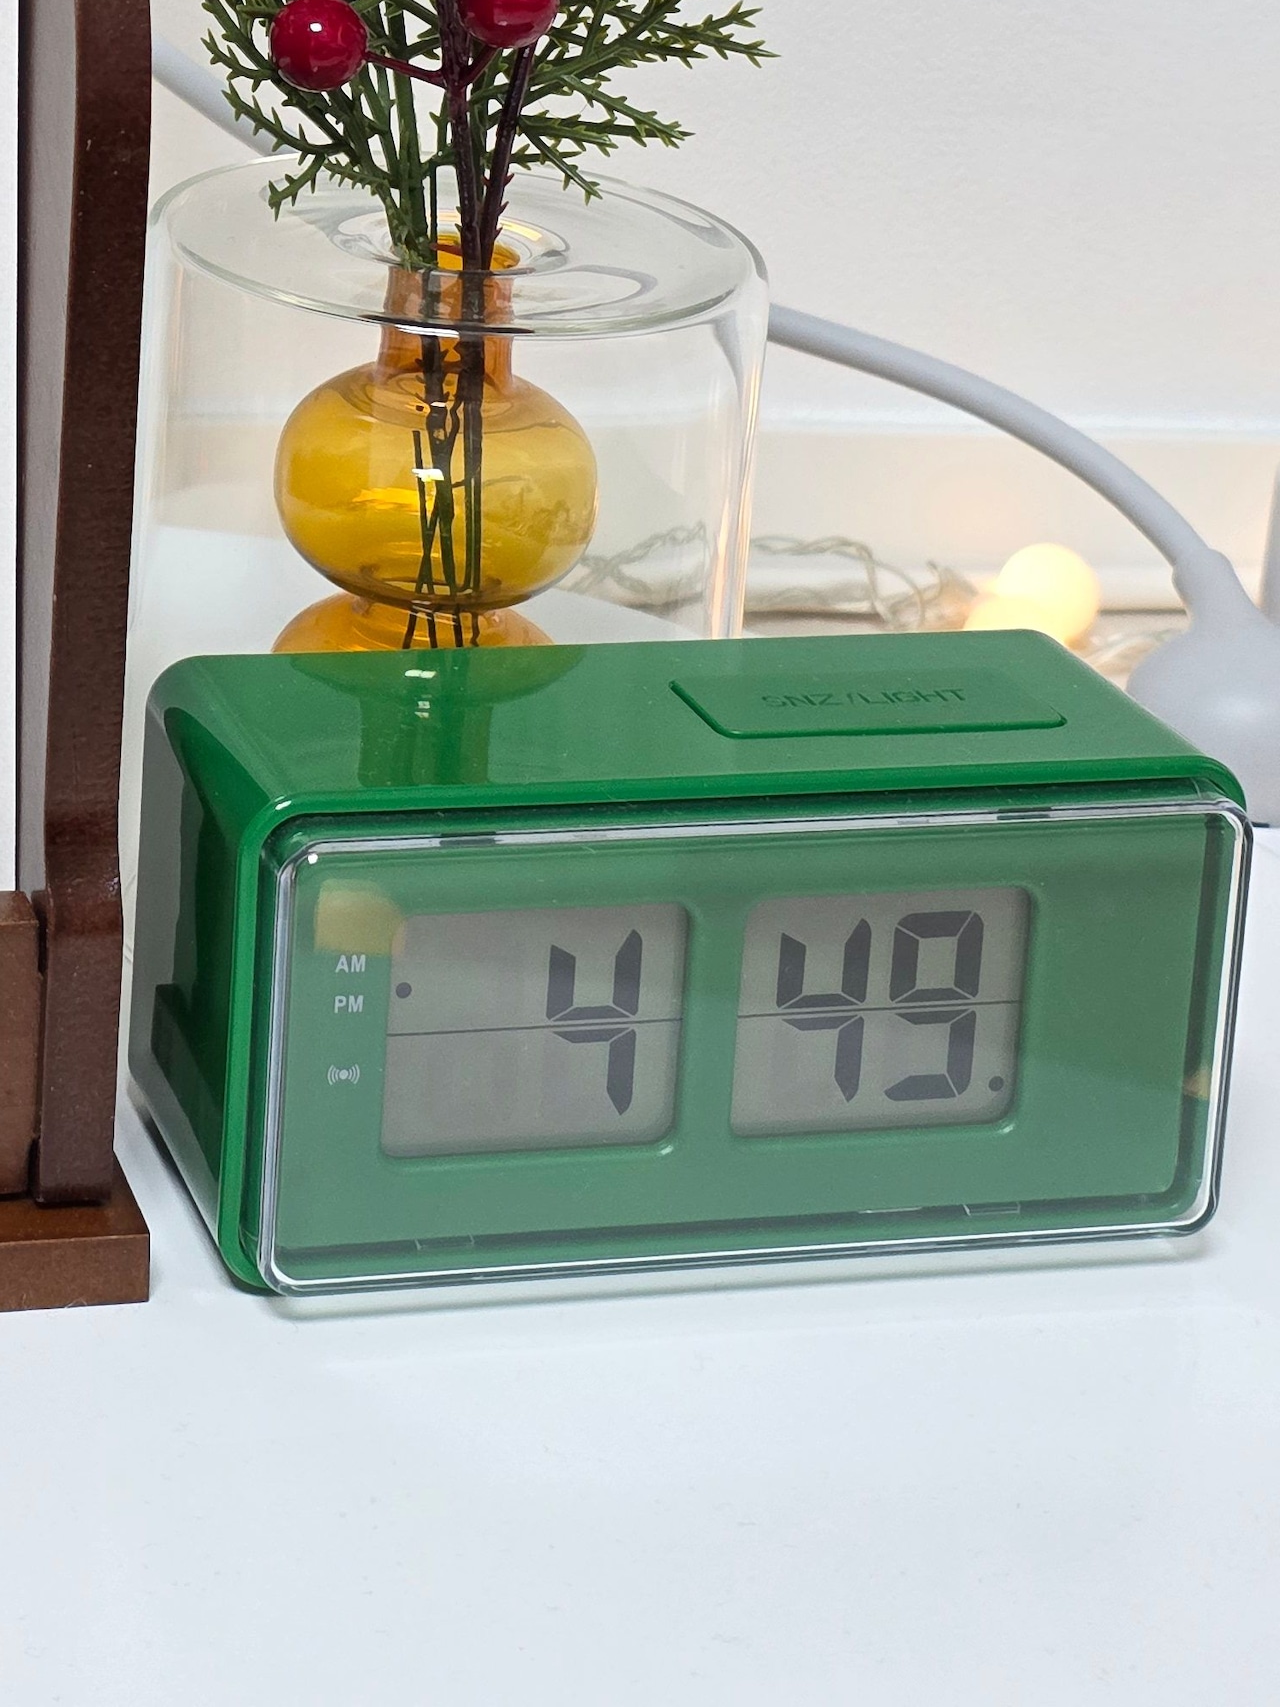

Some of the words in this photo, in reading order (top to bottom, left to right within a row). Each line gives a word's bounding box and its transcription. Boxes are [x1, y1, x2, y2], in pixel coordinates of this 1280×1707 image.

[761, 688, 967, 708] SNZ/LIGHT
[335, 954, 366, 973] AM
[334, 995, 364, 1013] PM
[546, 929, 642, 1116] 4
[776, 910, 984, 1103] 49
